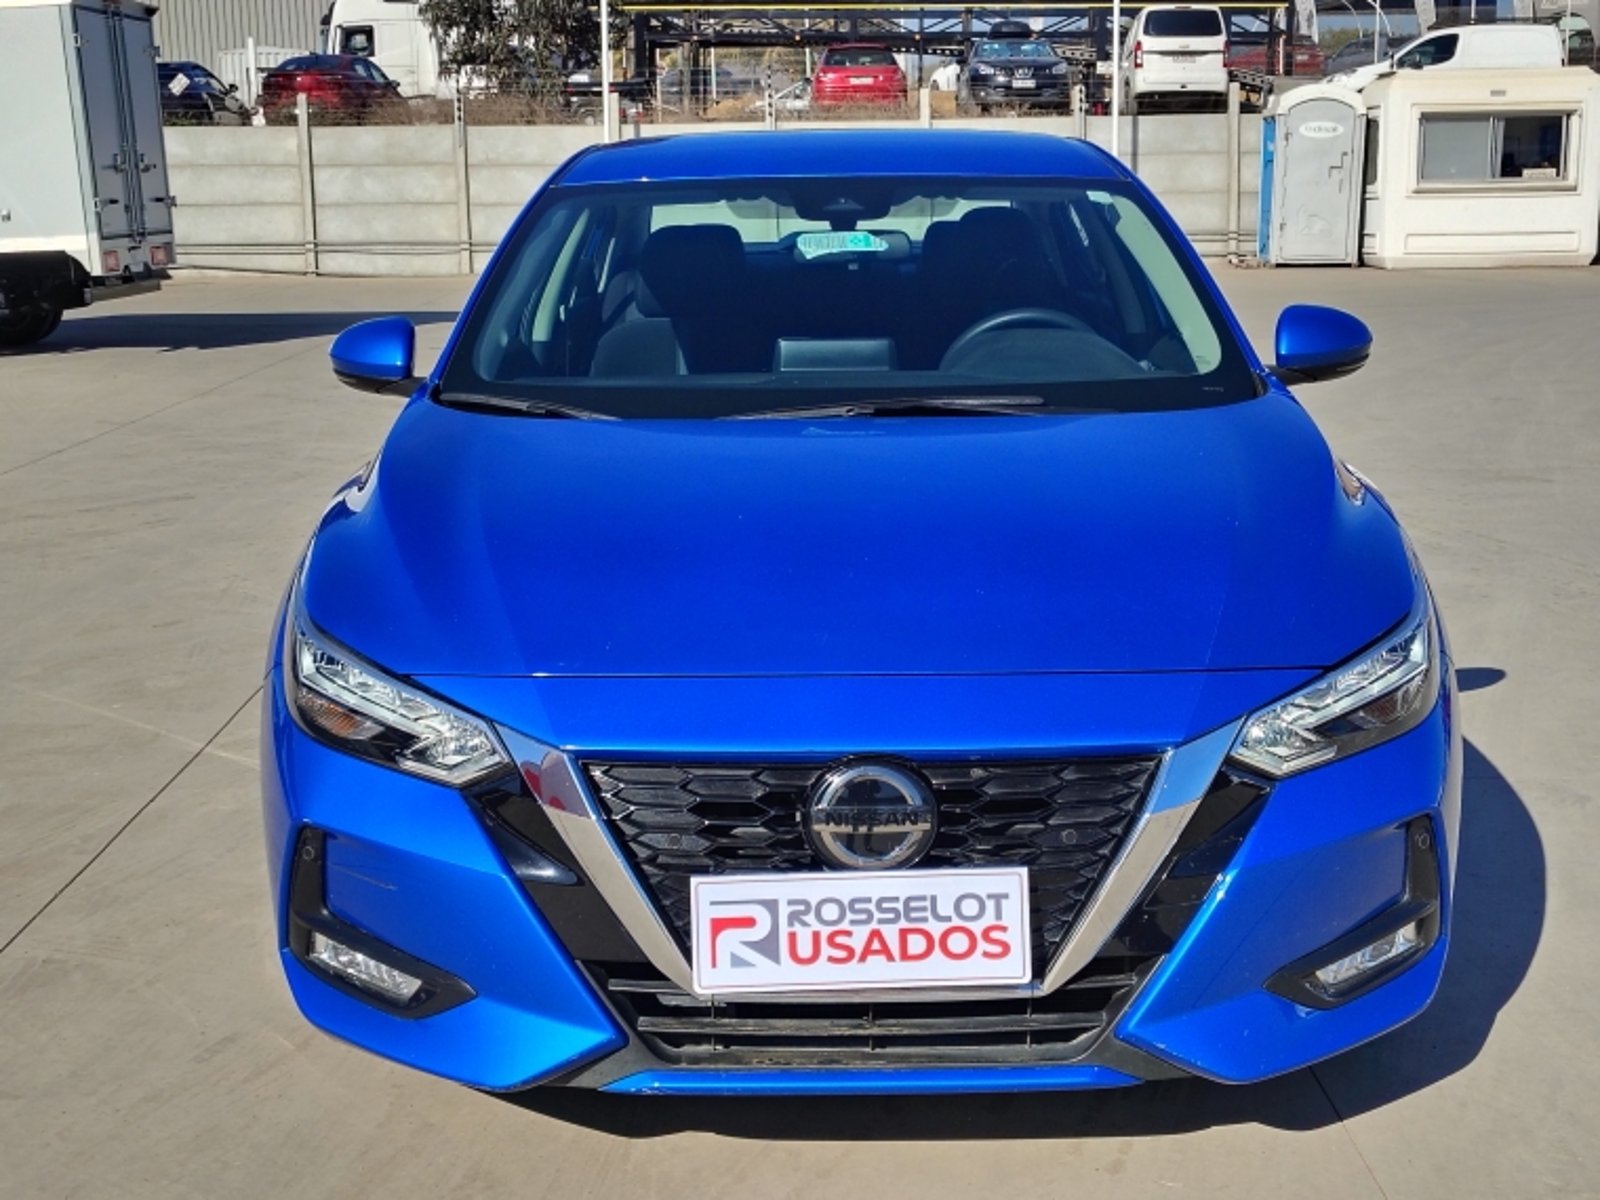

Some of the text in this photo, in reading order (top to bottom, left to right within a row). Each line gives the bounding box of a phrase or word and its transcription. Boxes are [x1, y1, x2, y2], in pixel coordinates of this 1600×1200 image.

[825, 811, 919, 827] NISSAN
[787, 892, 1009, 927] ROSSELOT
[788, 924, 1011, 965] USADOS
